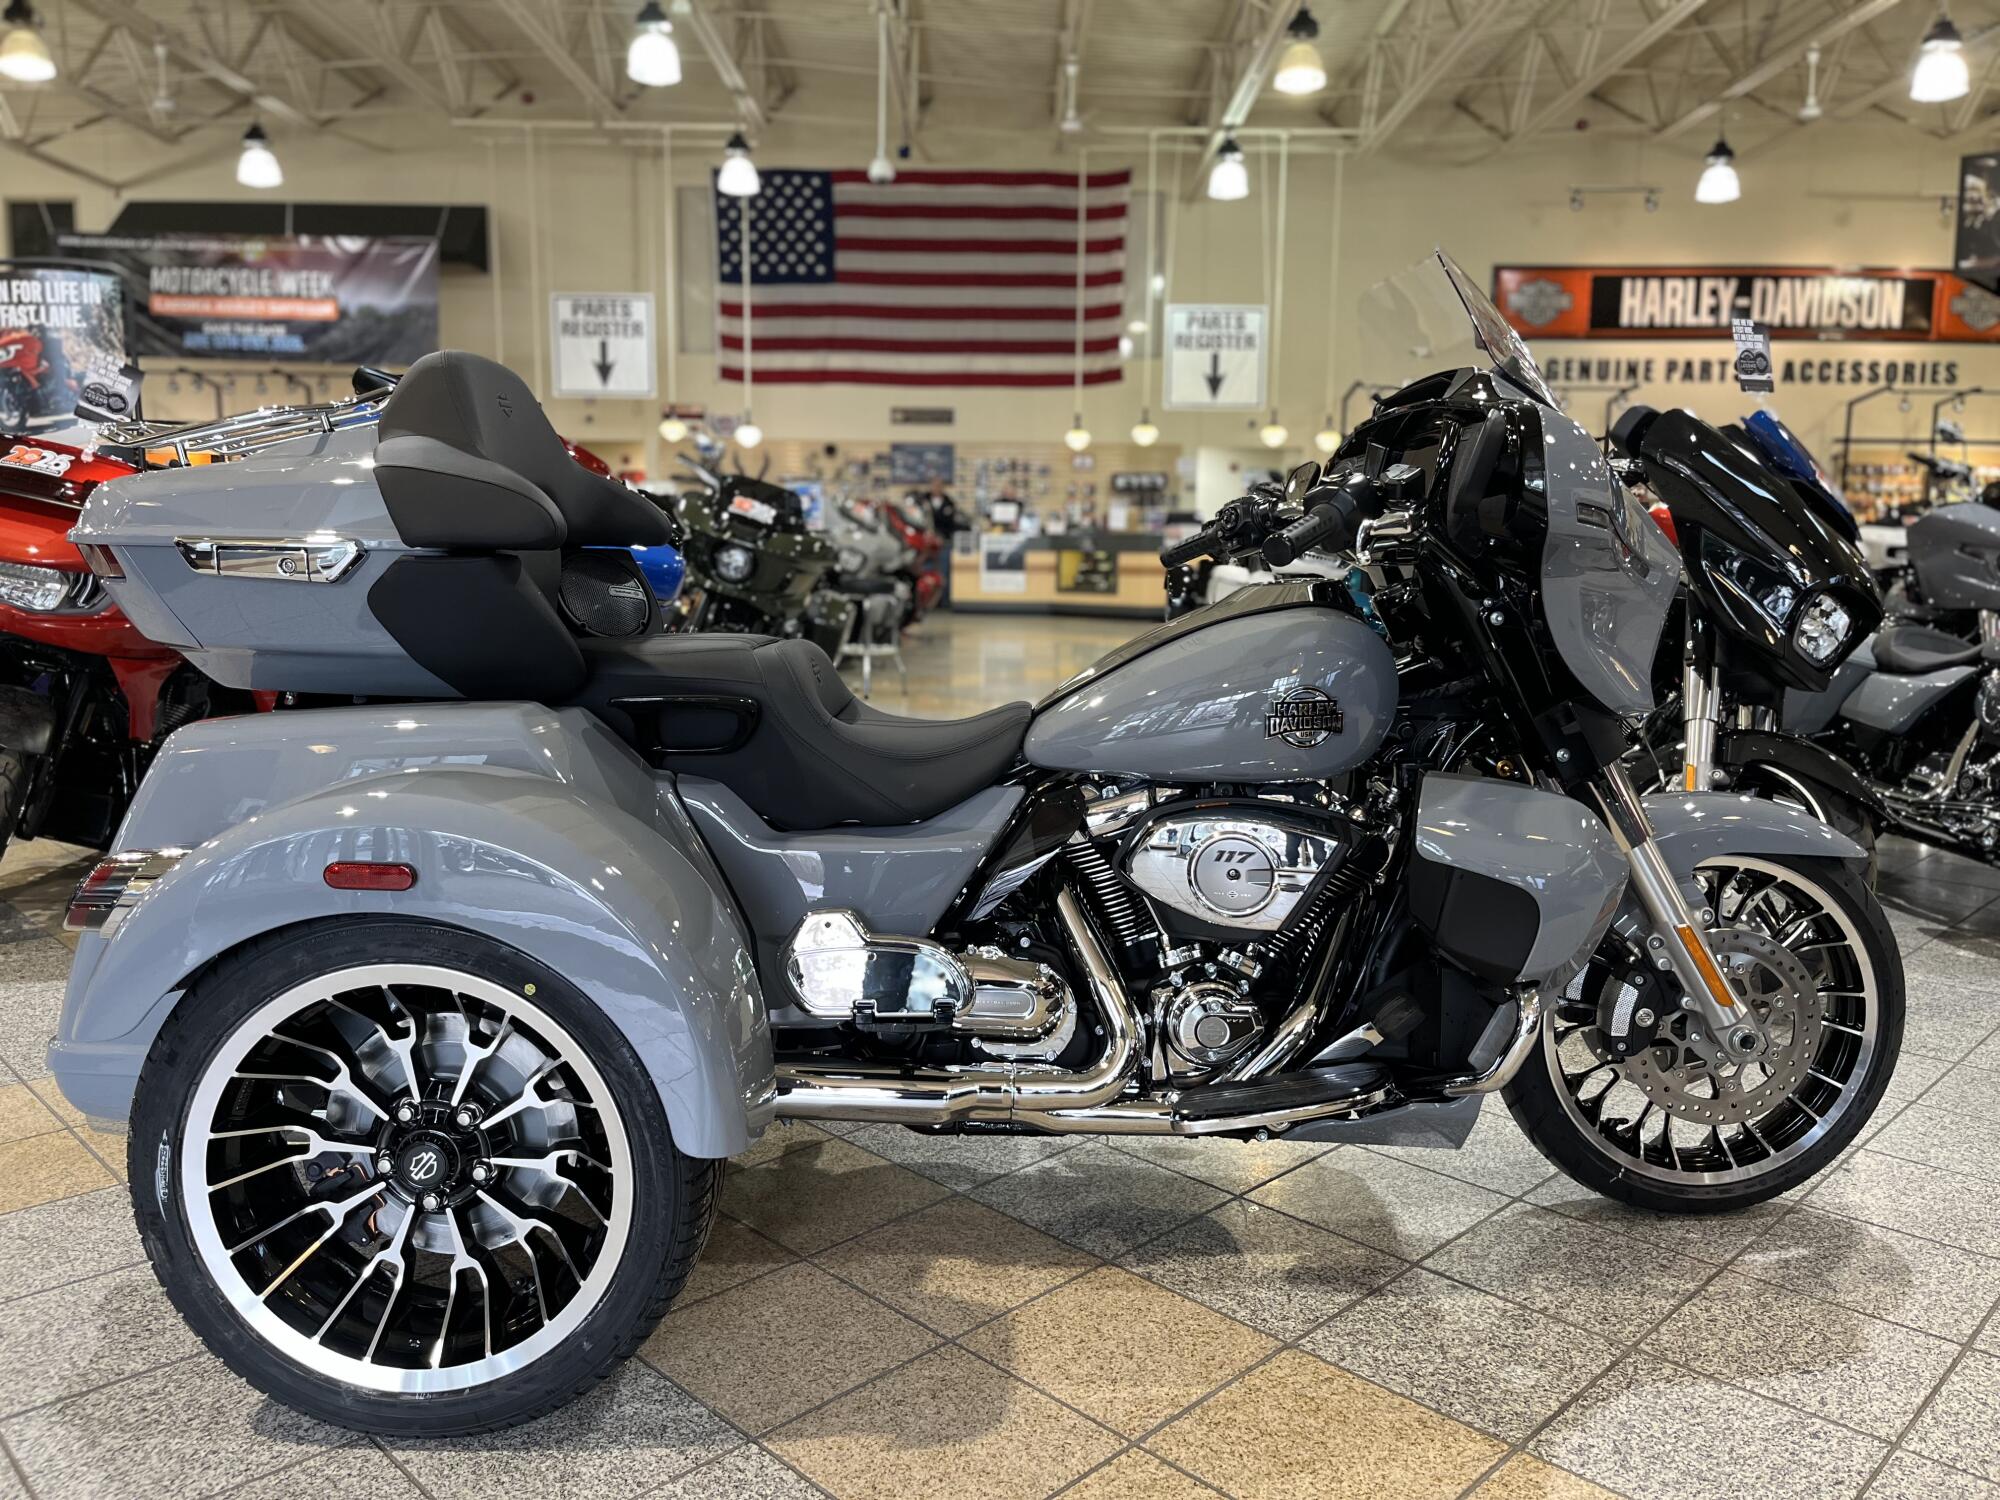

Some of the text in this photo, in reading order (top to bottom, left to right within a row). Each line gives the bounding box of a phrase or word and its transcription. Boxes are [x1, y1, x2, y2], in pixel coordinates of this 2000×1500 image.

[11, 280, 42, 304] FOR
[45, 281, 80, 304] LIFE
[82, 282, 101, 304] IN
[150, 267, 335, 298] MOTORCYCLE WEEK
[570, 299, 633, 318] PARTS
[1619, 277, 1905, 329] HARLEY-DAVIDSON
[0, 304, 38, 328] FAST
[560, 320, 644, 338] REGISTER
[1545, 358, 1958, 384] GENUINE PART ACCESSORIES
[1269, 715, 1342, 735] DAVIDSON
[1213, 849, 1257, 864] 117
